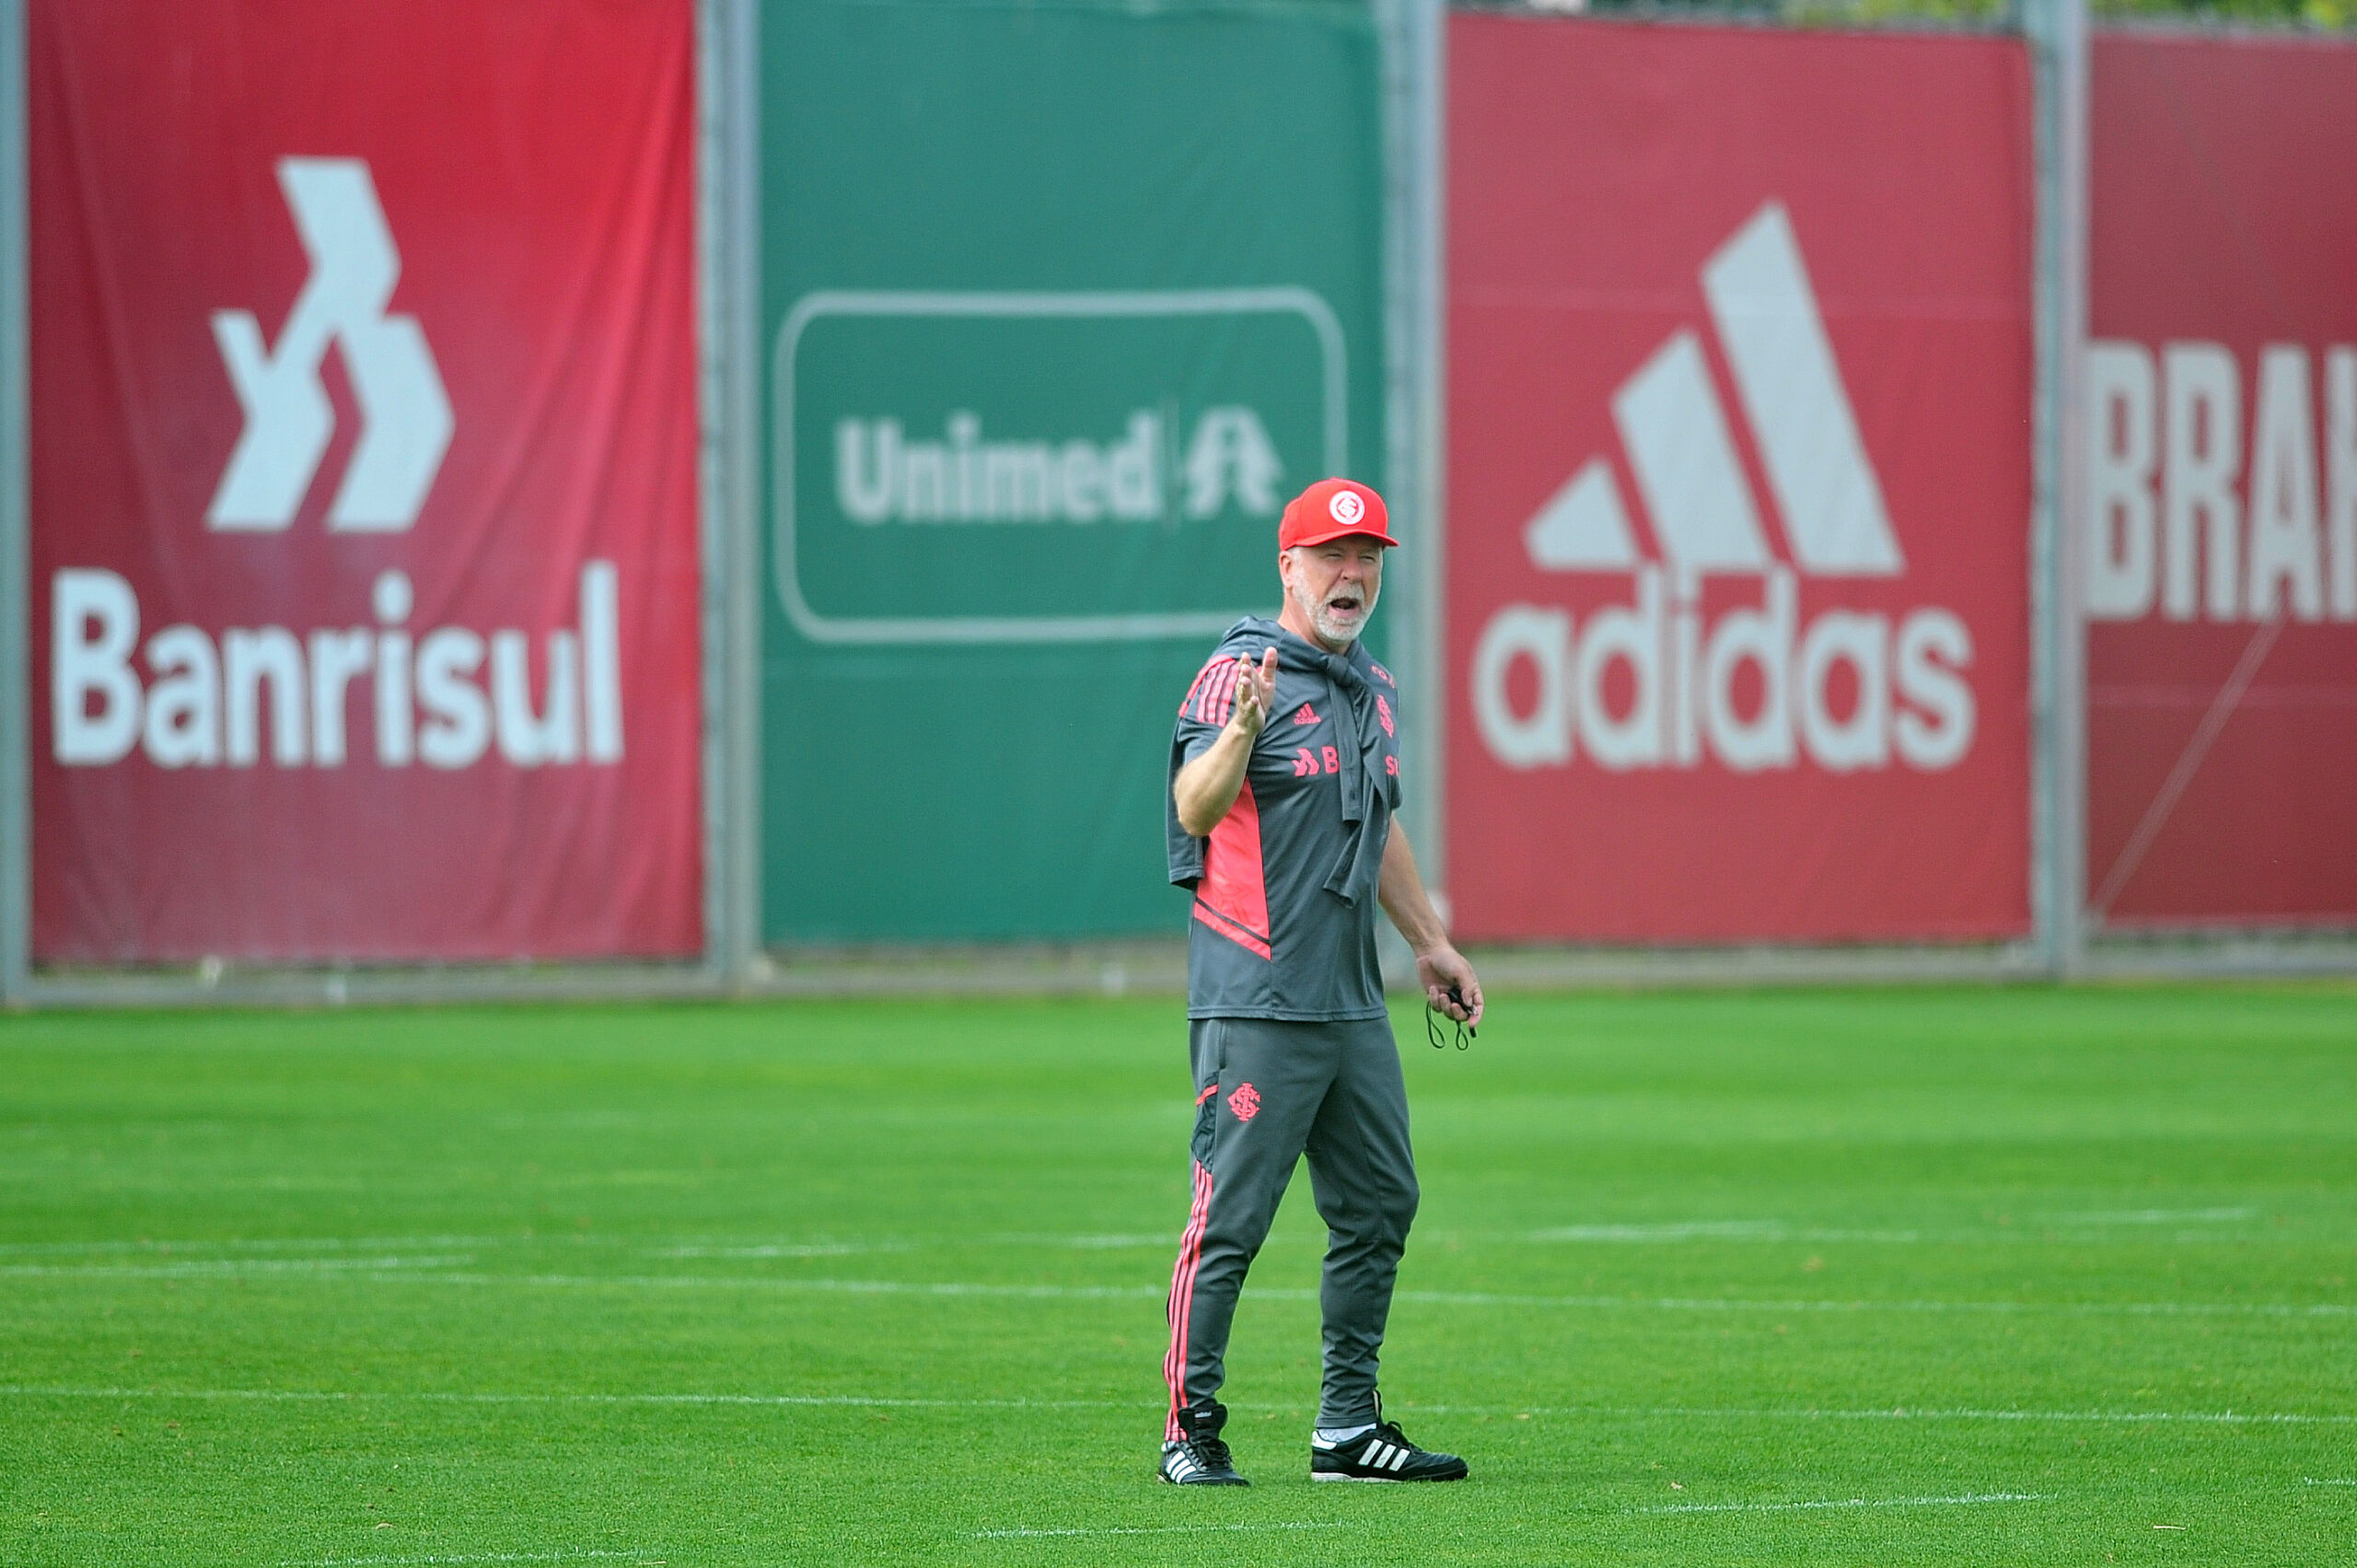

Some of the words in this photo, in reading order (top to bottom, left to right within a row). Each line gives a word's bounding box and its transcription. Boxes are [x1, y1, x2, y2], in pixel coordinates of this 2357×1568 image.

[837, 411, 1164, 524] Unimed
[52, 559, 623, 768] Banrisul
[1474, 563, 1976, 772] adidas
